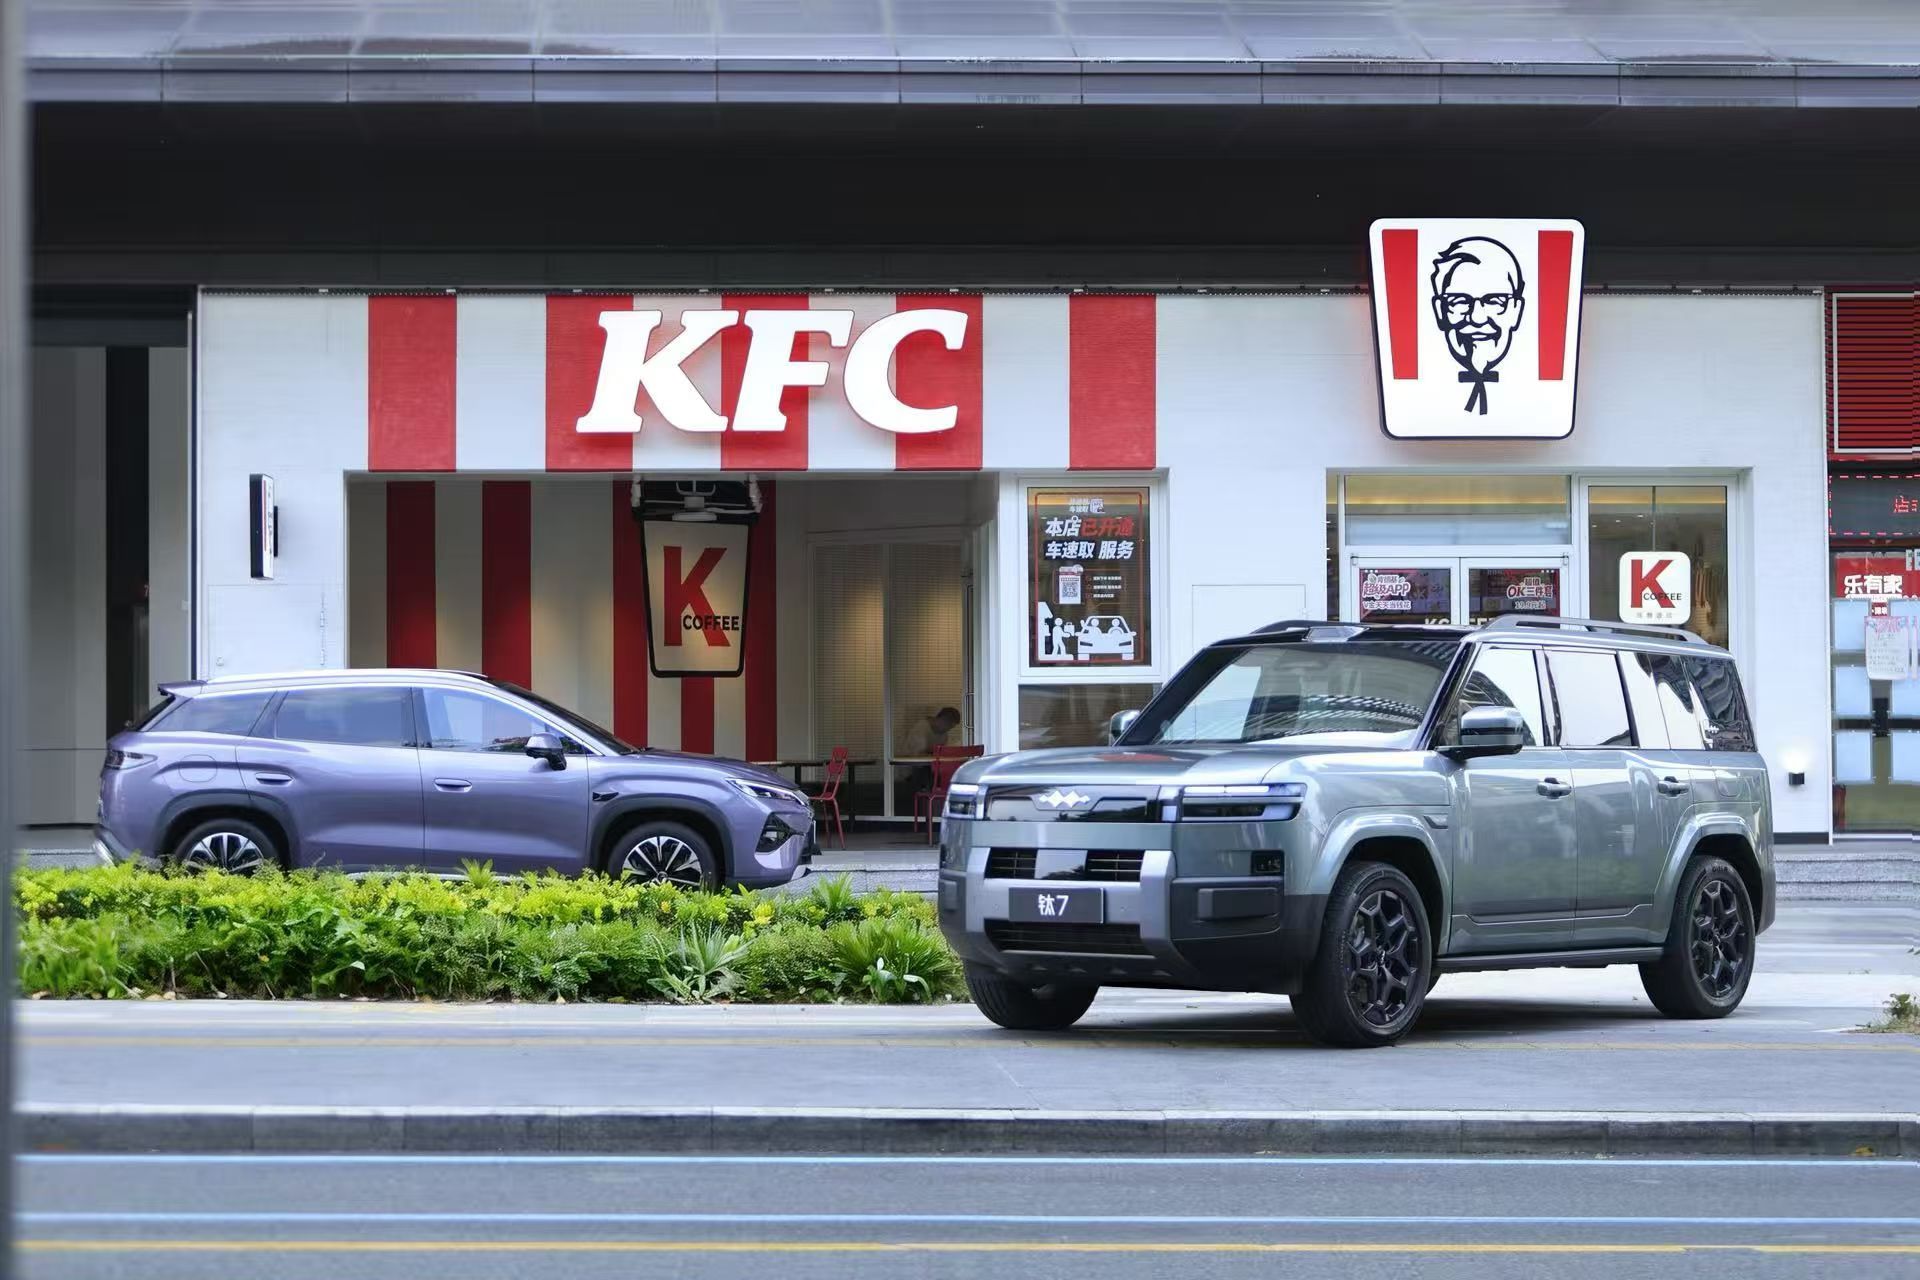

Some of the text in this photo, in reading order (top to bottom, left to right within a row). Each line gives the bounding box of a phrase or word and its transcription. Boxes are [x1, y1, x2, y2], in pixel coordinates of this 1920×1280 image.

[576, 309, 968, 434] KFC
[1045, 516, 1134, 537] 本店已开通
[1045, 541, 1134, 560] 车速取 服务
[1363, 582, 1411, 597] 超级APP
[1507, 584, 1553, 599] OK三件套
[1630, 559, 1676, 608] K
[1844, 574, 1903, 594] 乐有家
[663, 546, 740, 647] K COFFEE
[1643, 592, 1682, 600] COFFEE
[1038, 893, 1069, 916] 钛7
